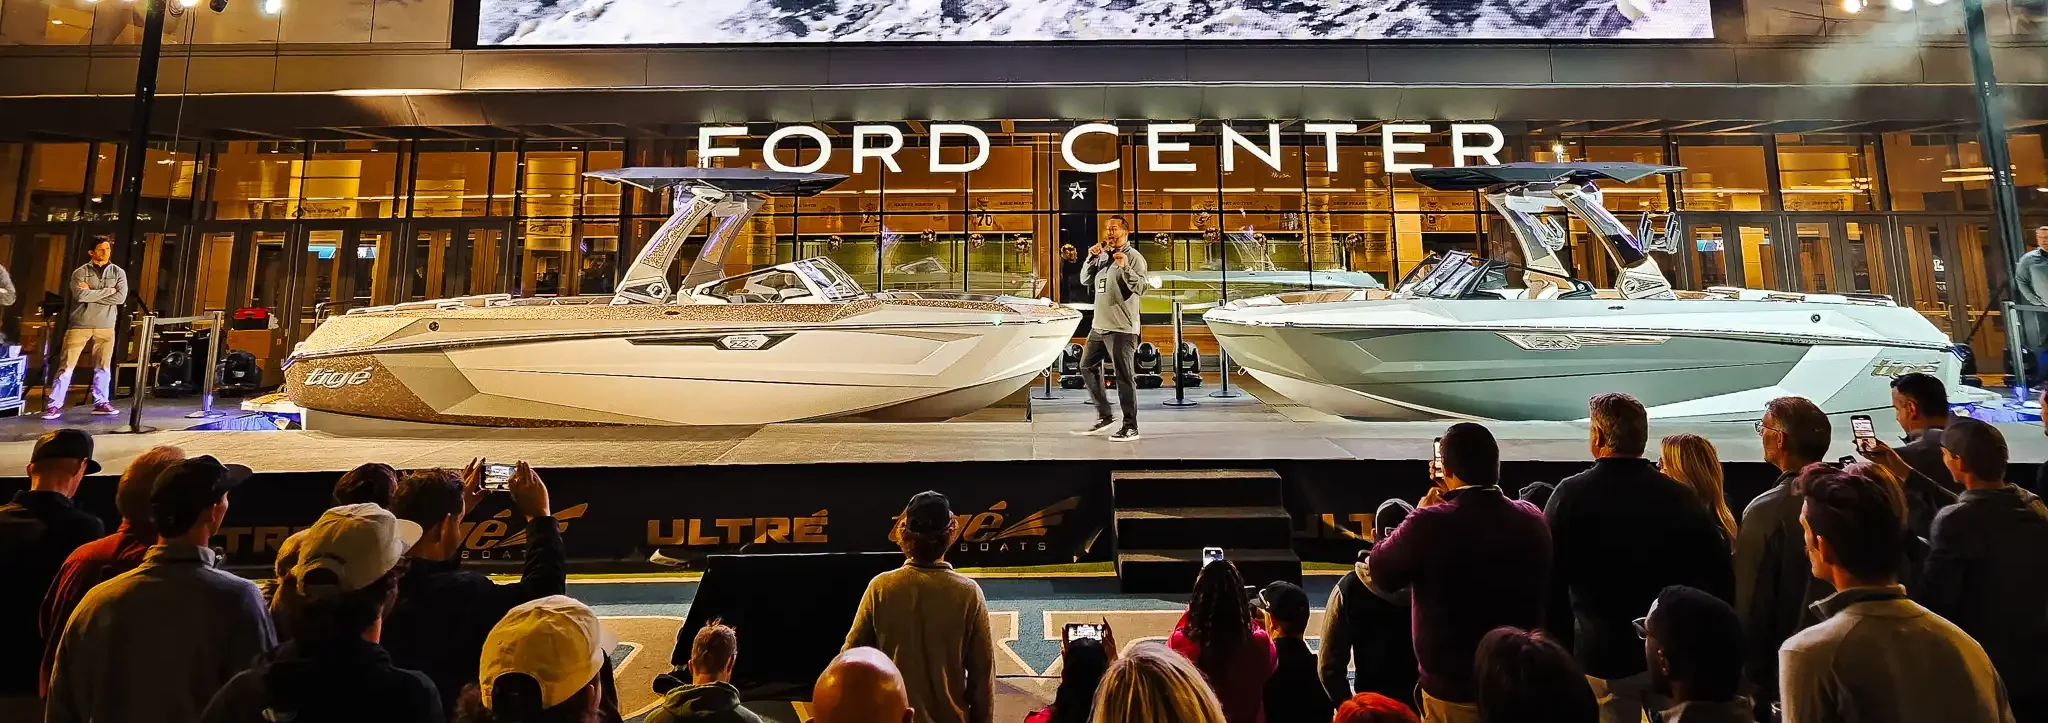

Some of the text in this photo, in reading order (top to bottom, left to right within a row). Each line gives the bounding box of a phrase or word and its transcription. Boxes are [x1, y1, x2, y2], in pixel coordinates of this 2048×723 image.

[699, 123, 1505, 173] FORD CENTER
[304, 366, 373, 389] tigé
[647, 509, 828, 546] ULTRÉ
[460, 549, 529, 560] BOAT
[960, 541, 1047, 552] BOATS
